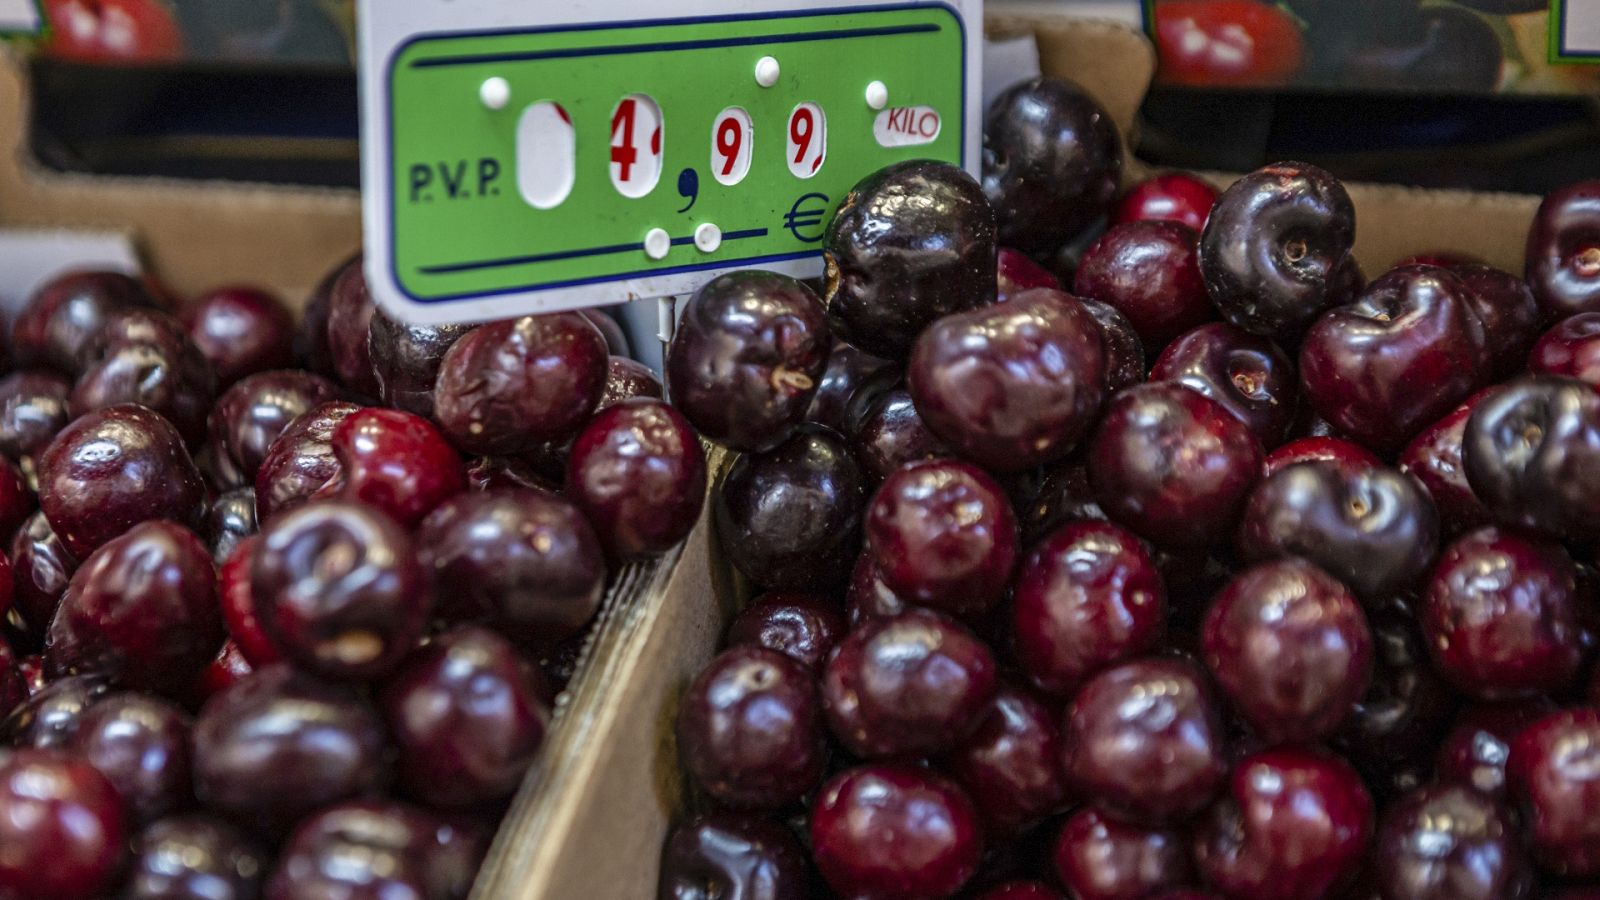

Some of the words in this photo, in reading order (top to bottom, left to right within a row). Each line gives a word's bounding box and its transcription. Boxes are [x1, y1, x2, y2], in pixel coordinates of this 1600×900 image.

[887, 107, 939, 138] KILO
[409, 157, 501, 204] P.V.P.
[783, 193, 830, 243] €
